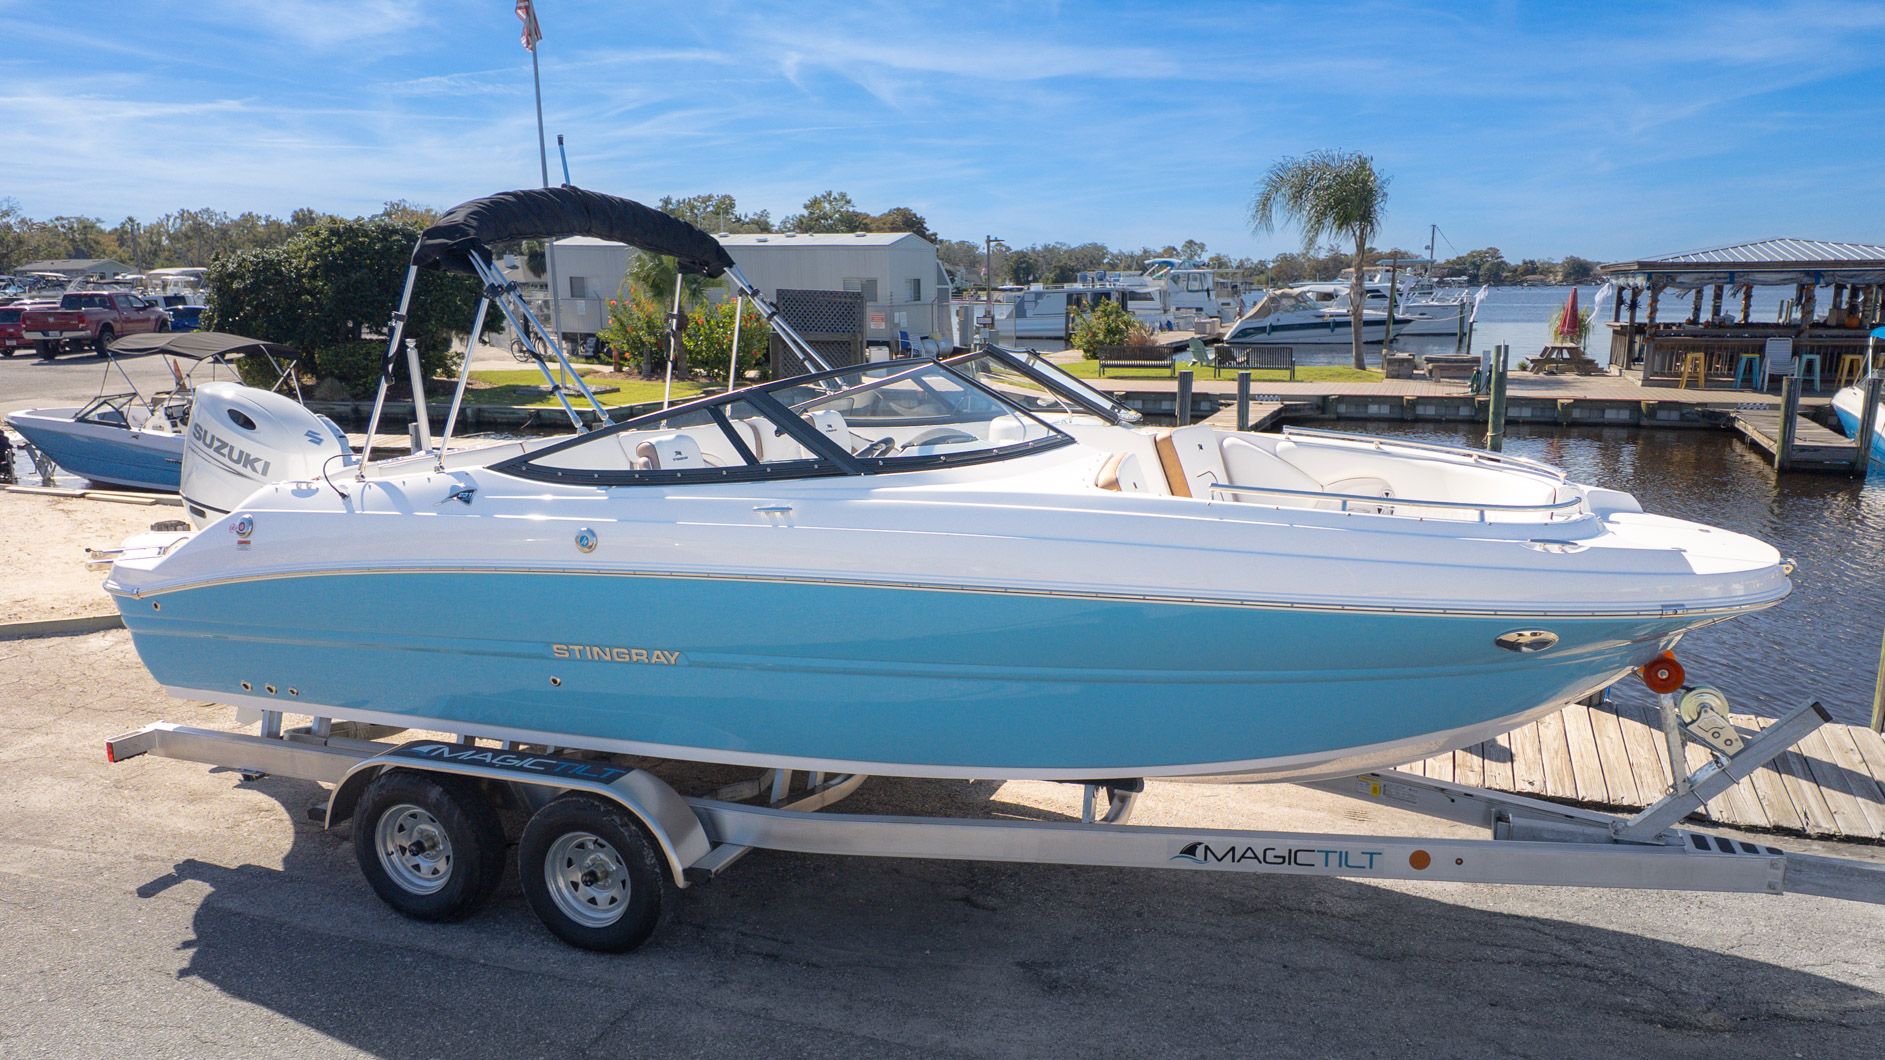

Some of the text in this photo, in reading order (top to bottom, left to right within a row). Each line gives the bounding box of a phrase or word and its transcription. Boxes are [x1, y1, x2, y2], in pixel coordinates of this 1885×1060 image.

[193, 422, 271, 477] SUZUKI
[552, 643, 680, 665] STINGRAY
[430, 745, 626, 779] MAGICTILT
[1203, 844, 1383, 870] MAGICTILT
